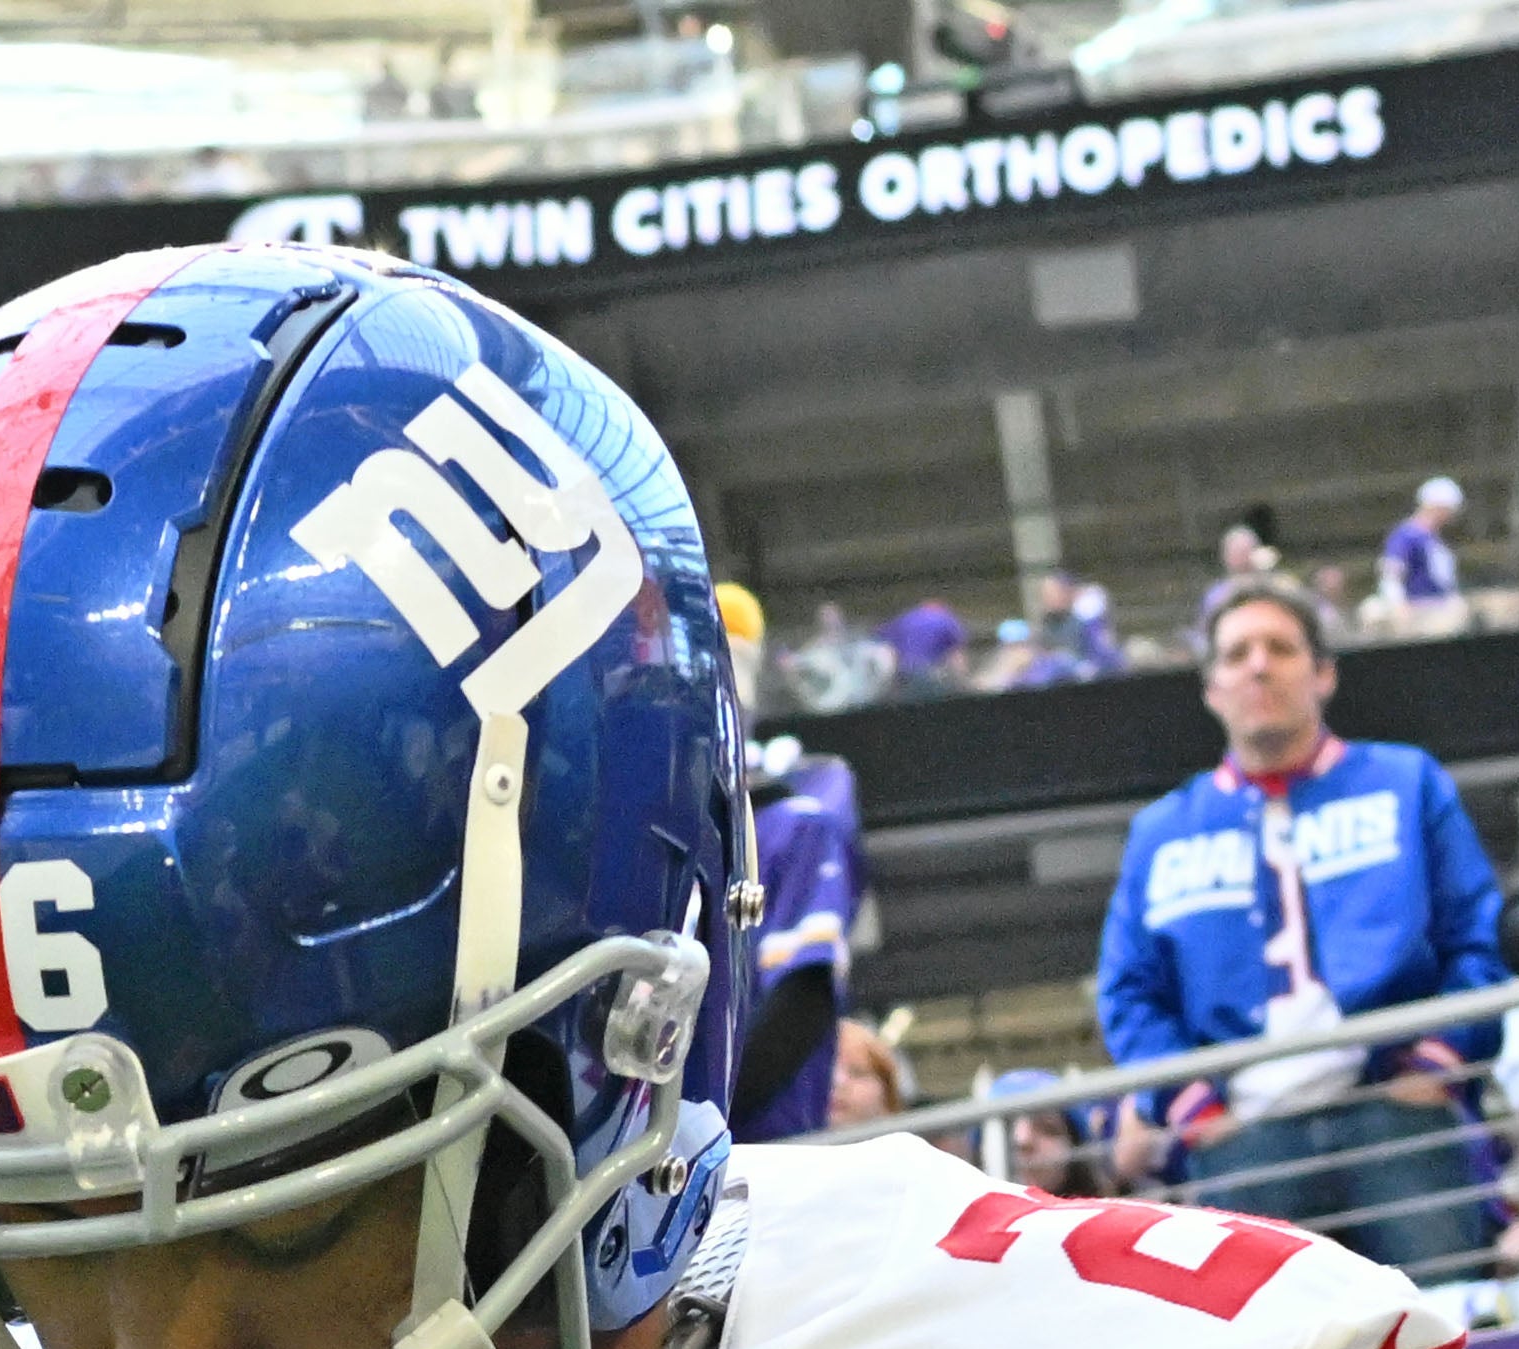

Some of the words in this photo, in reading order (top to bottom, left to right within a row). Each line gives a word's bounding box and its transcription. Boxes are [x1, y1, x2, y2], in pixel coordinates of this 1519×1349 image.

[400, 199, 593, 269] TWIN
[611, 162, 842, 255] CITIES
[859, 86, 1384, 221] ORTHOPEDICS
